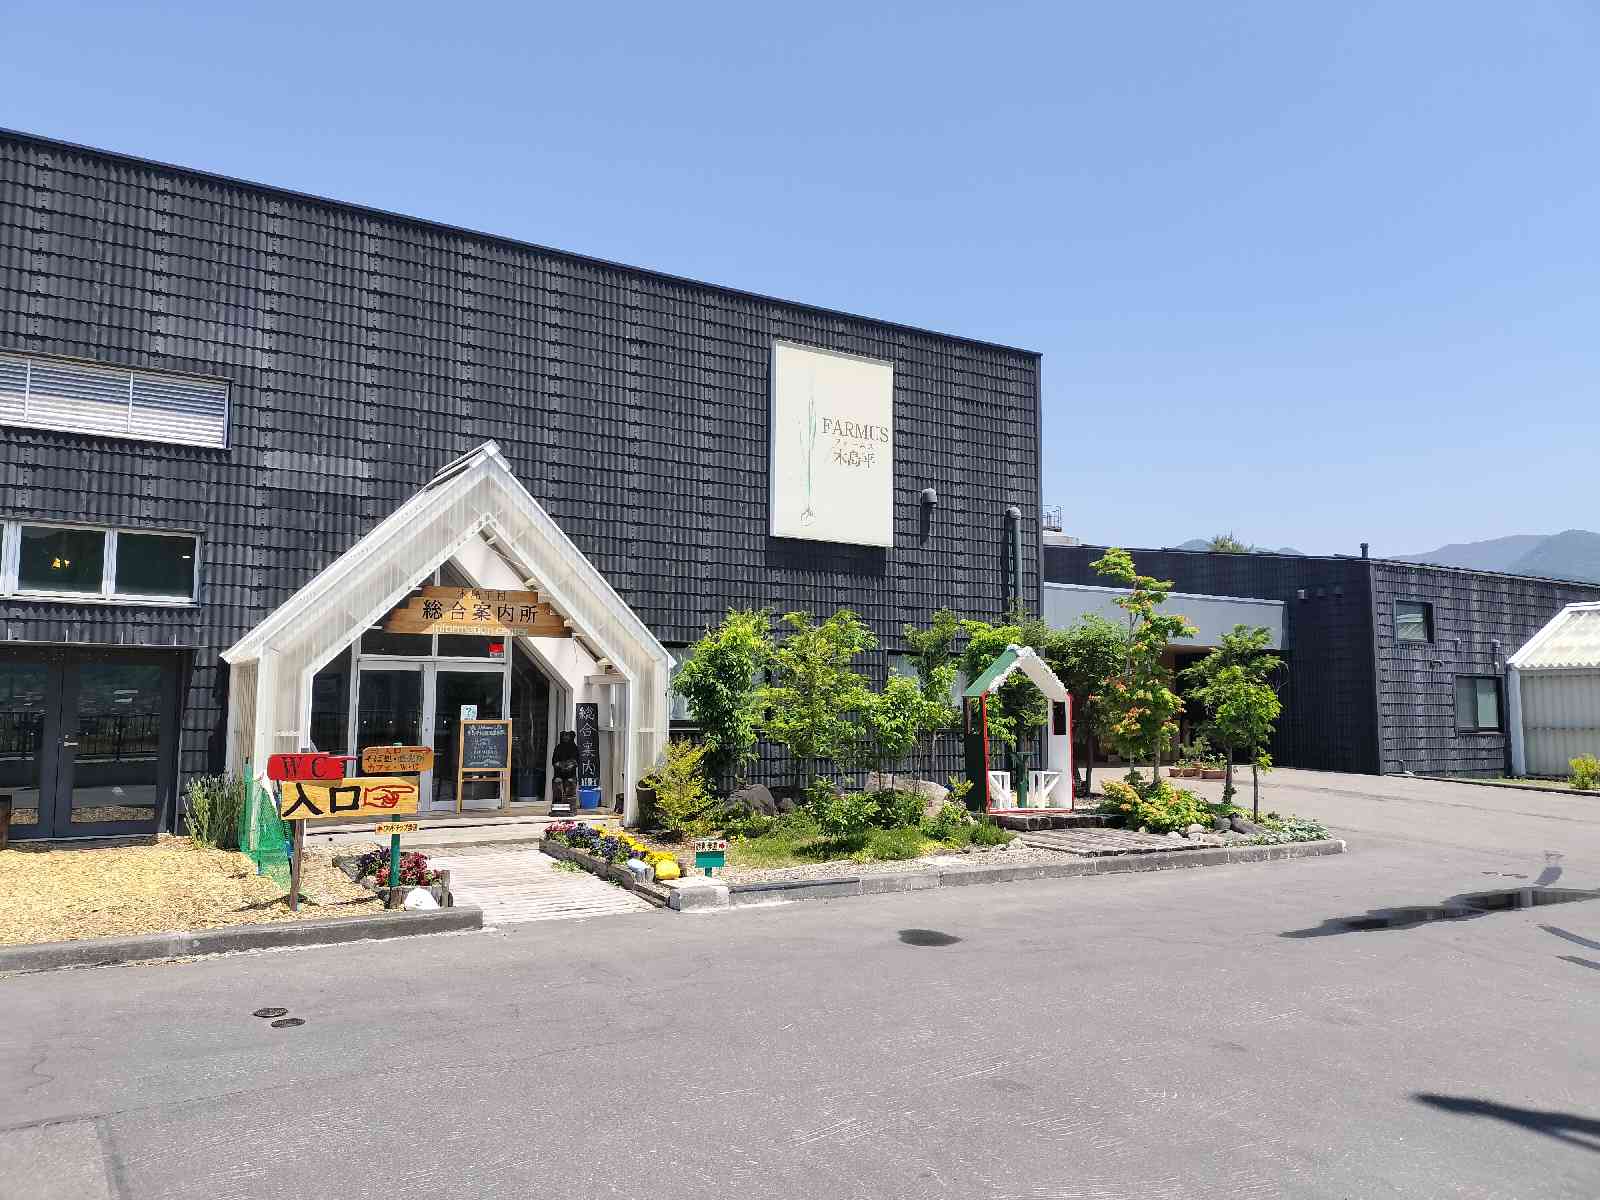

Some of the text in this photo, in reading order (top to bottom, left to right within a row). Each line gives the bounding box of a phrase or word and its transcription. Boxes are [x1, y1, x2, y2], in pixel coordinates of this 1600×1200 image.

[821, 416, 889, 443] FARMUS
[422, 599, 539, 624] 総合案内所
[578, 705, 598, 777] 総合案内
[281, 782, 362, 818] 入口
